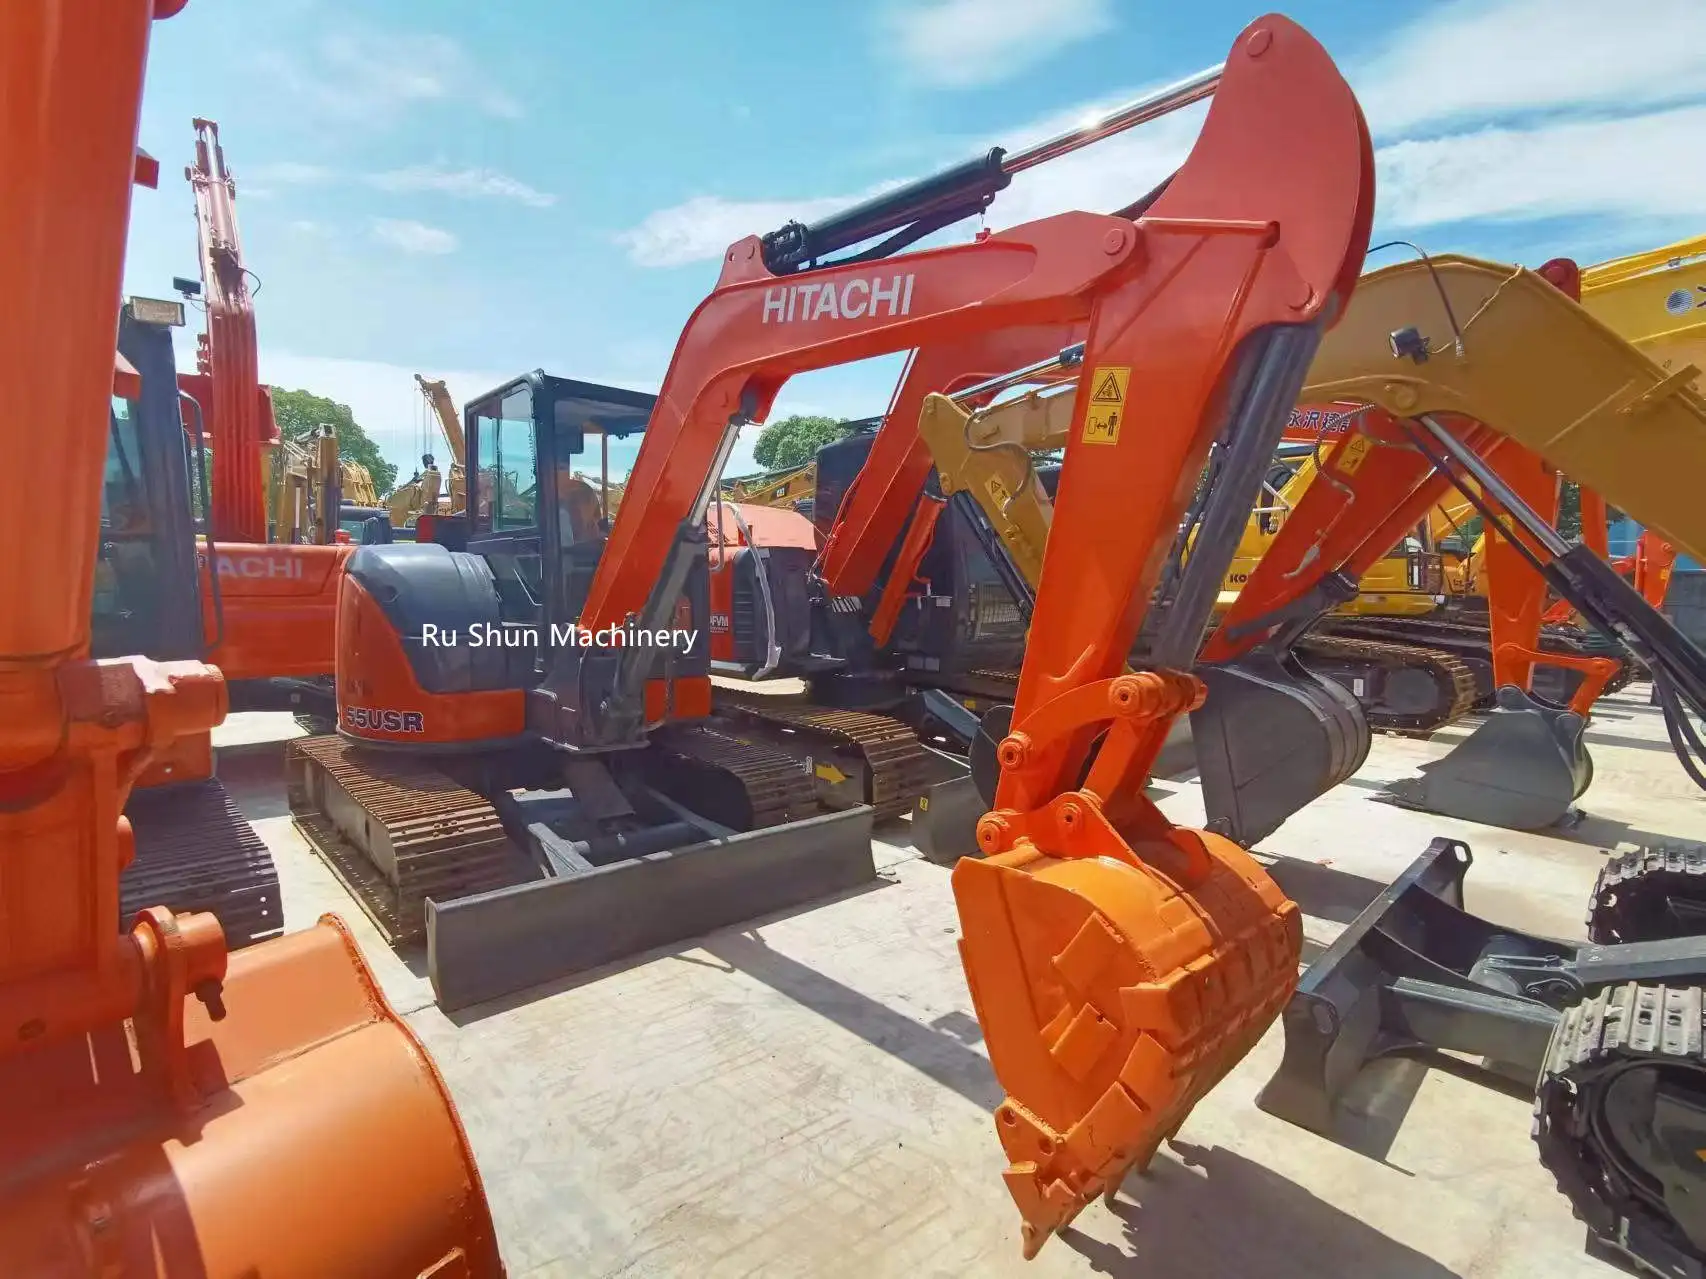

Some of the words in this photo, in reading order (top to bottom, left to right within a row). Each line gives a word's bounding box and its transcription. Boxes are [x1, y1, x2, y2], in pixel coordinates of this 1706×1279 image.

[762, 274, 915, 323] HITACHI
[217, 556, 303, 578] ACHI
[346, 705, 424, 733] 55USR
